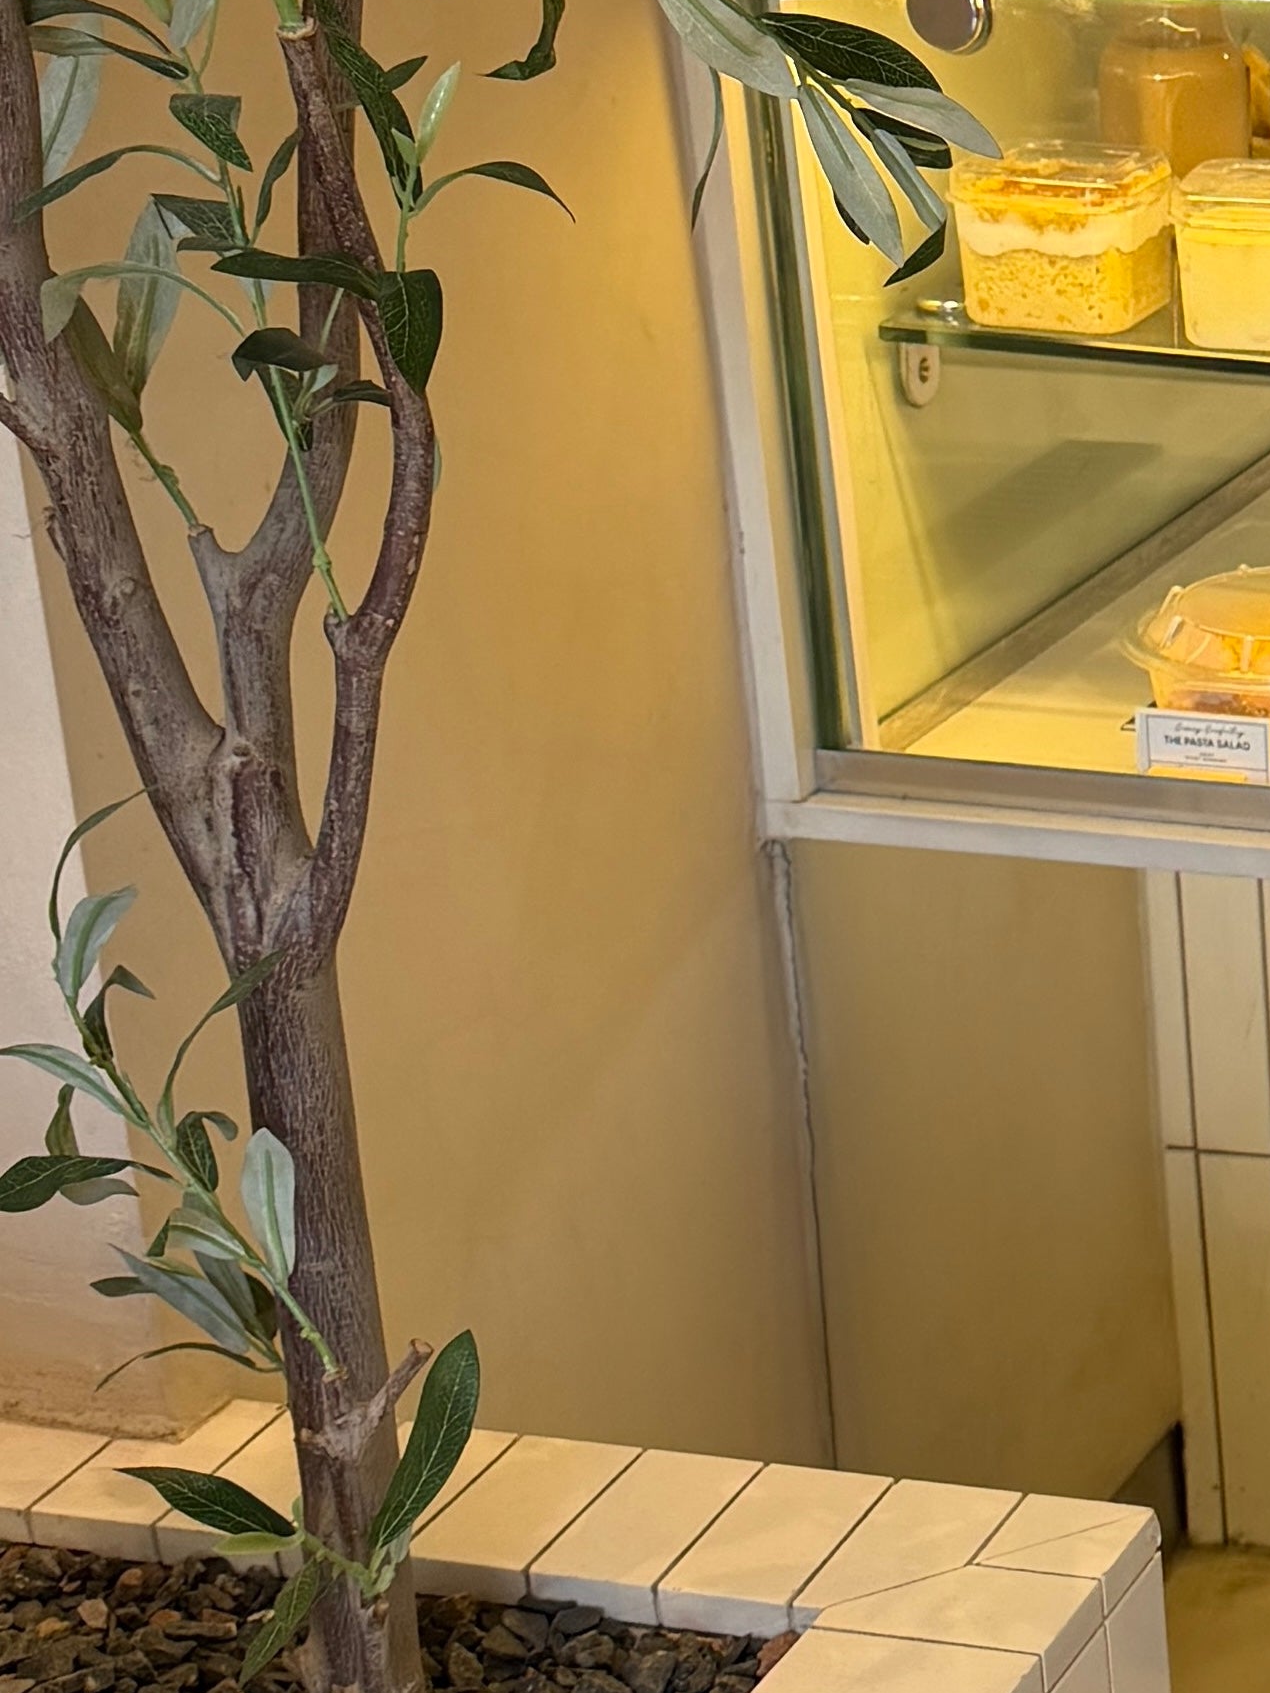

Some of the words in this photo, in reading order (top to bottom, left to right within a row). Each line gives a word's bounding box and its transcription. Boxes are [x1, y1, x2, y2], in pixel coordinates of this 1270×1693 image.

[1164, 734, 1182, 746] THE
[1184, 736, 1215, 748] PASTA
[1217, 738, 1251, 752] SALAD
